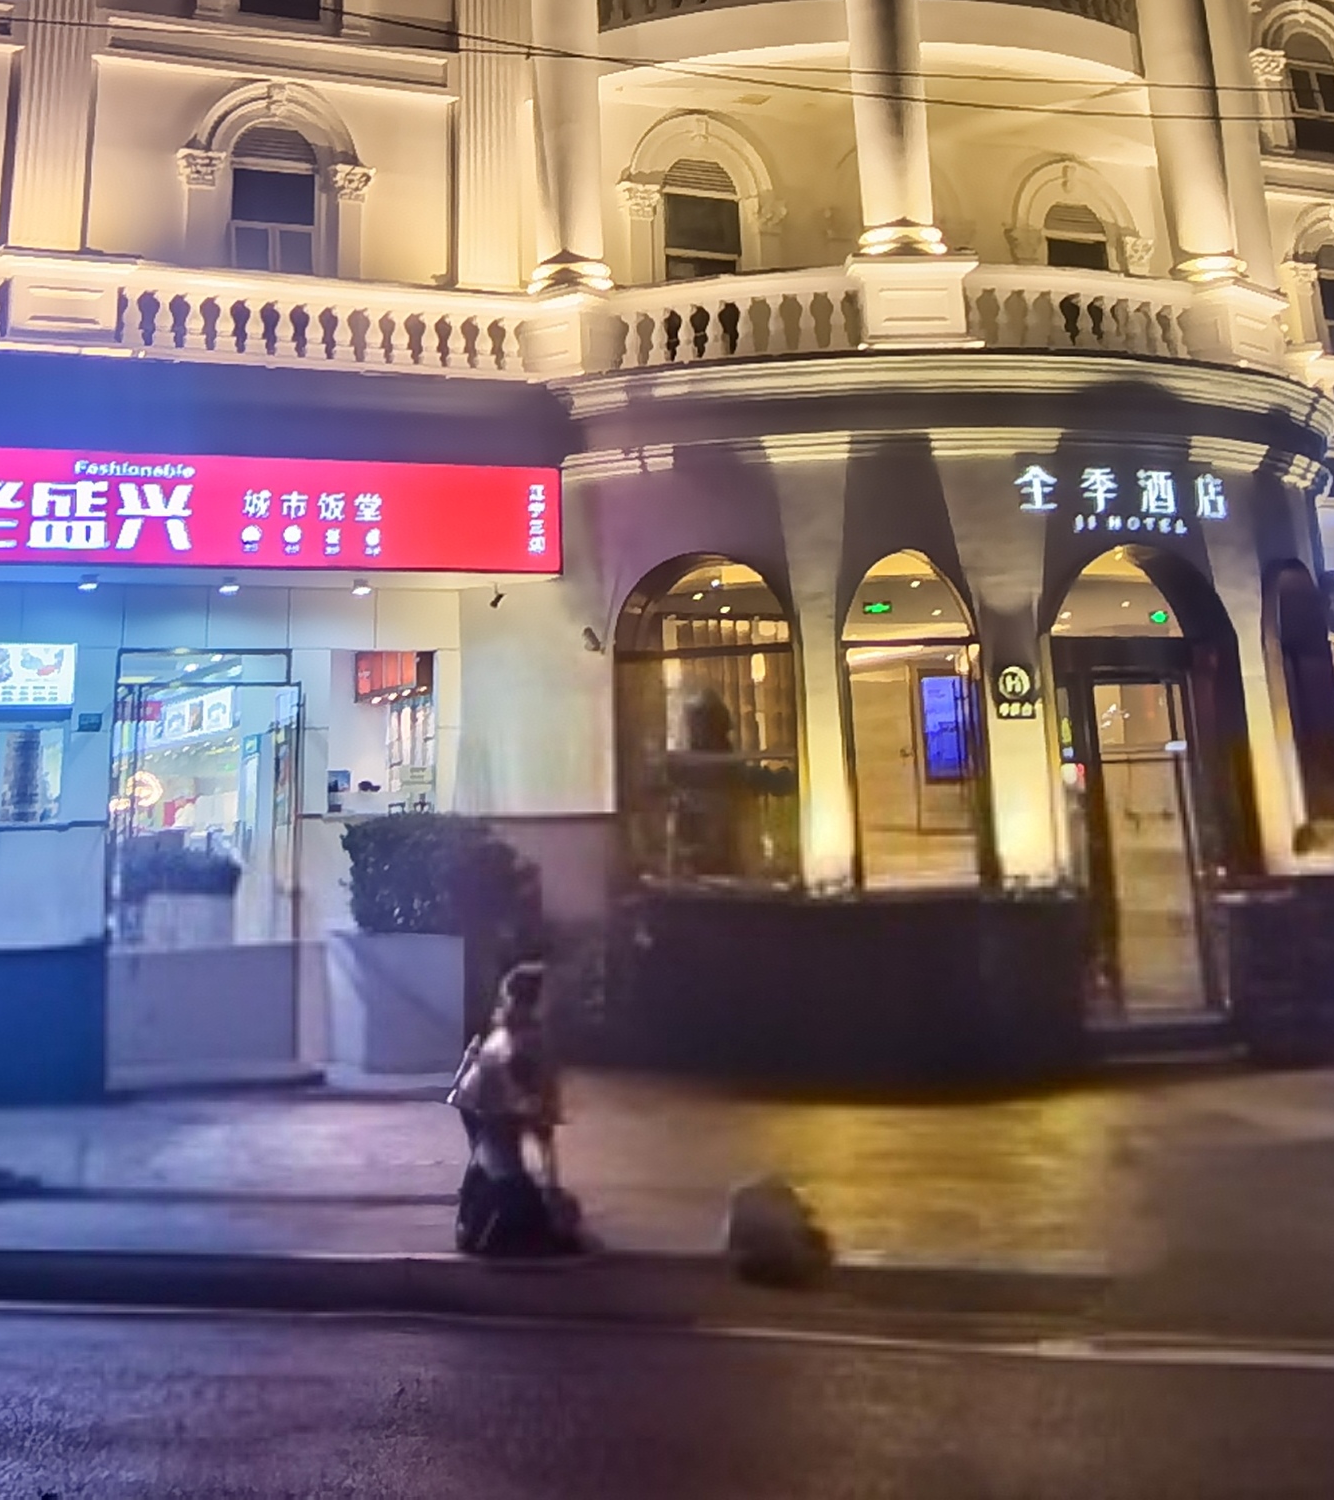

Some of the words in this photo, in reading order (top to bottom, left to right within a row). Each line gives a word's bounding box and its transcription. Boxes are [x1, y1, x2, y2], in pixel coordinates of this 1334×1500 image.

[74, 459, 196, 479] Fashionable
[242, 488, 382, 522] 城市饭堂
[1014, 465, 1228, 520] 全季酒店
[1107, 515, 1188, 535] HOTEL
